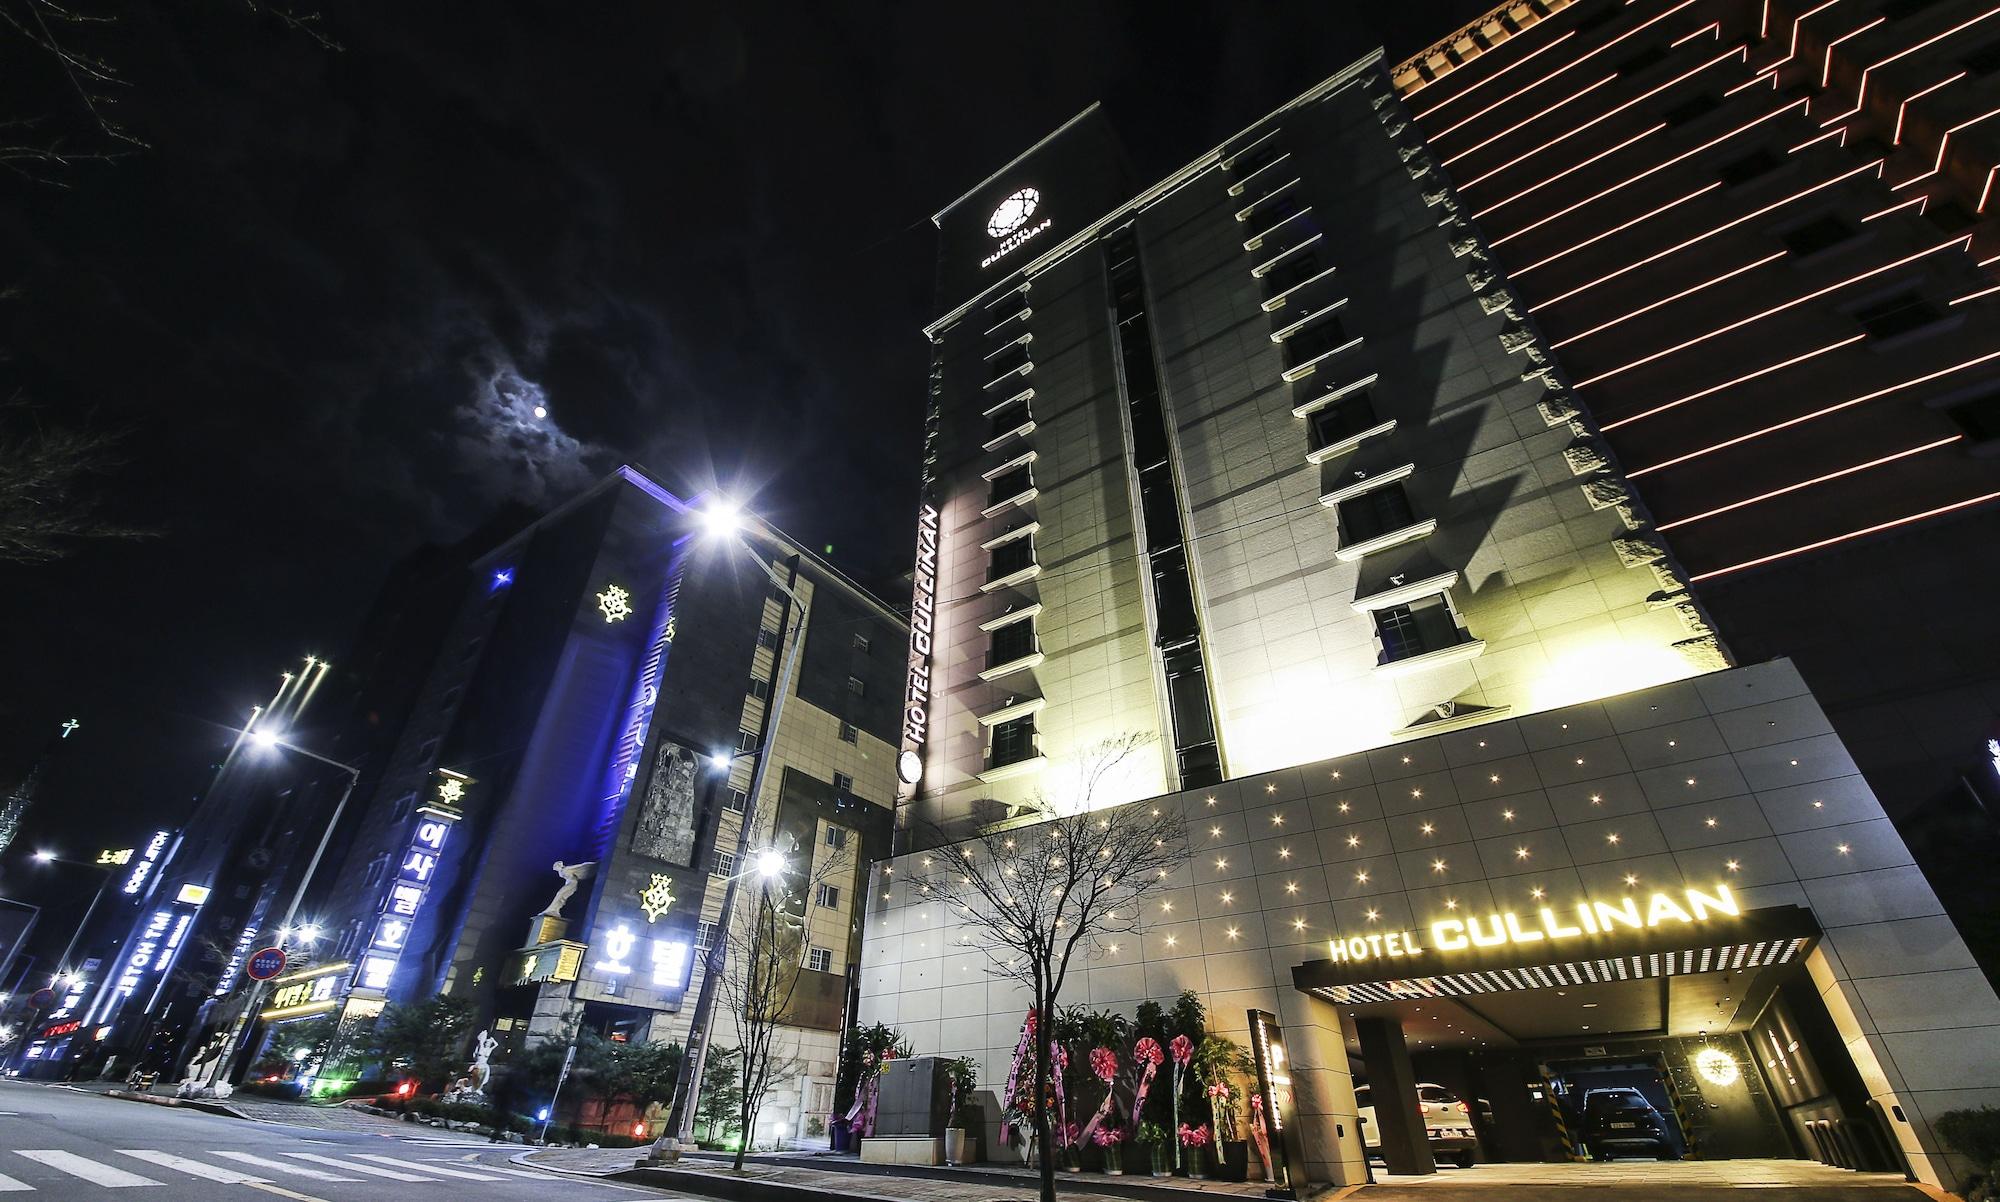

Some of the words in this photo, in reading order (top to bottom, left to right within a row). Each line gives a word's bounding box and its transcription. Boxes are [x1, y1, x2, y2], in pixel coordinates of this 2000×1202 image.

[982, 219, 1051, 268] CULLINAN
[912, 504, 939, 656] CULLINAN
[907, 665, 930, 745] HOTEL
[594, 925, 687, 988] 호텔
[1329, 931, 1422, 963] HOTEL
[1431, 884, 1741, 951] CULLINAN
[1271, 1044, 1284, 1070] P
